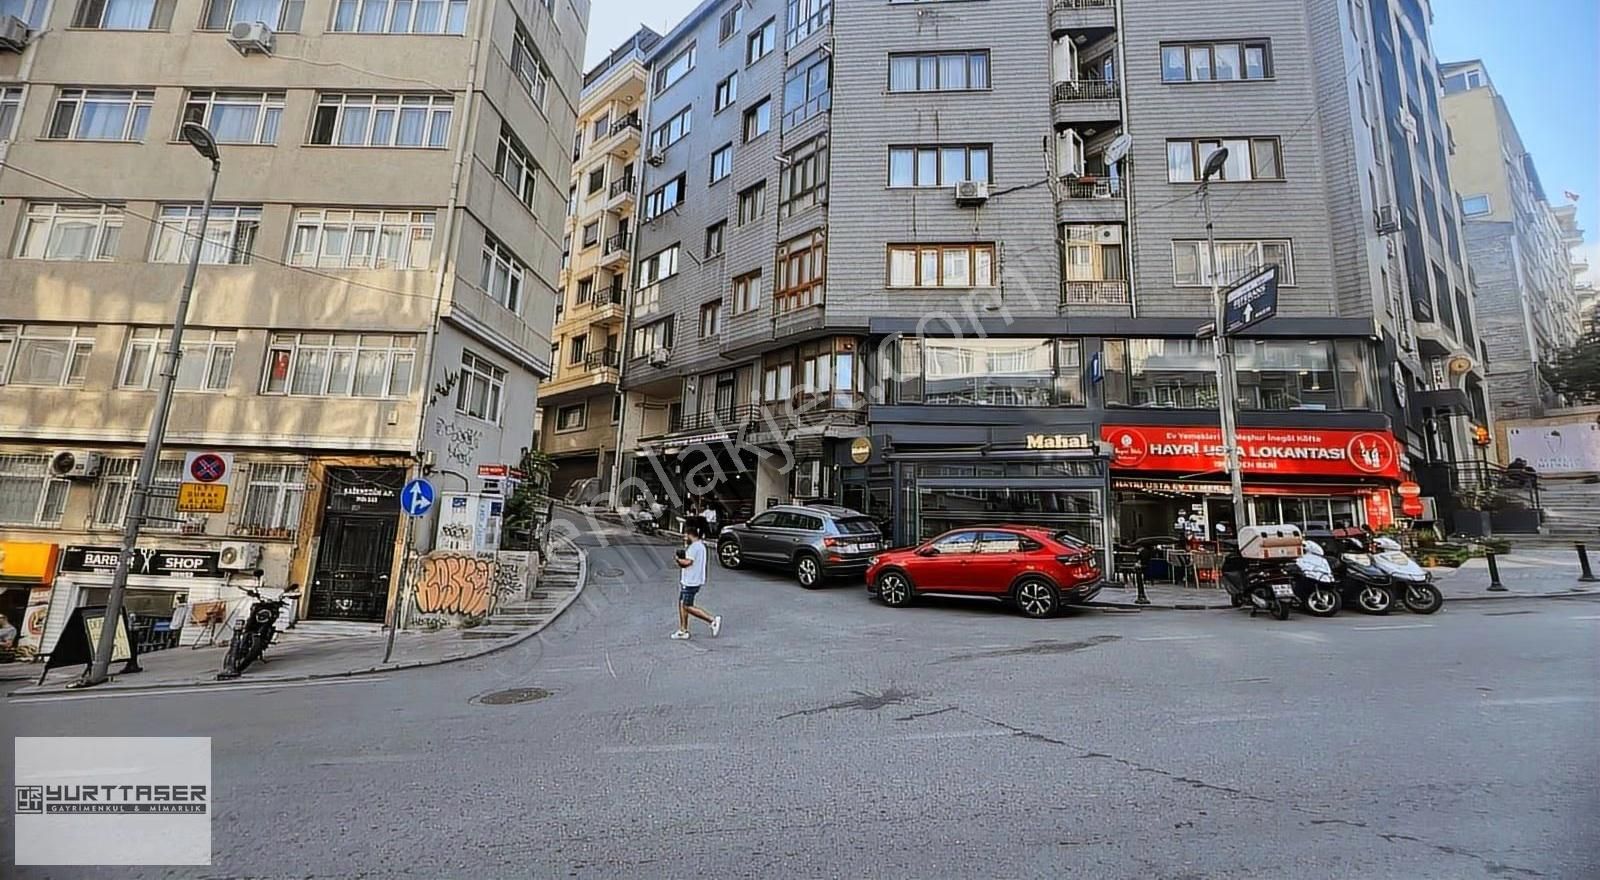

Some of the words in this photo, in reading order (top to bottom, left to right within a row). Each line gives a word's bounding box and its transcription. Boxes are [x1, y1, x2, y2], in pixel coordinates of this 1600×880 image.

[1026, 433, 1088, 449] Mahal
[1178, 432, 1221, 441] Yemekleri
[1149, 441, 1200, 456] HAYRİ
[1203, 444, 1246, 457] USA
[1252, 446, 1346, 459] LOKANTASI
[1187, 483, 1232, 492] YEMEKLE
[165, 557, 204, 569] SHOP
